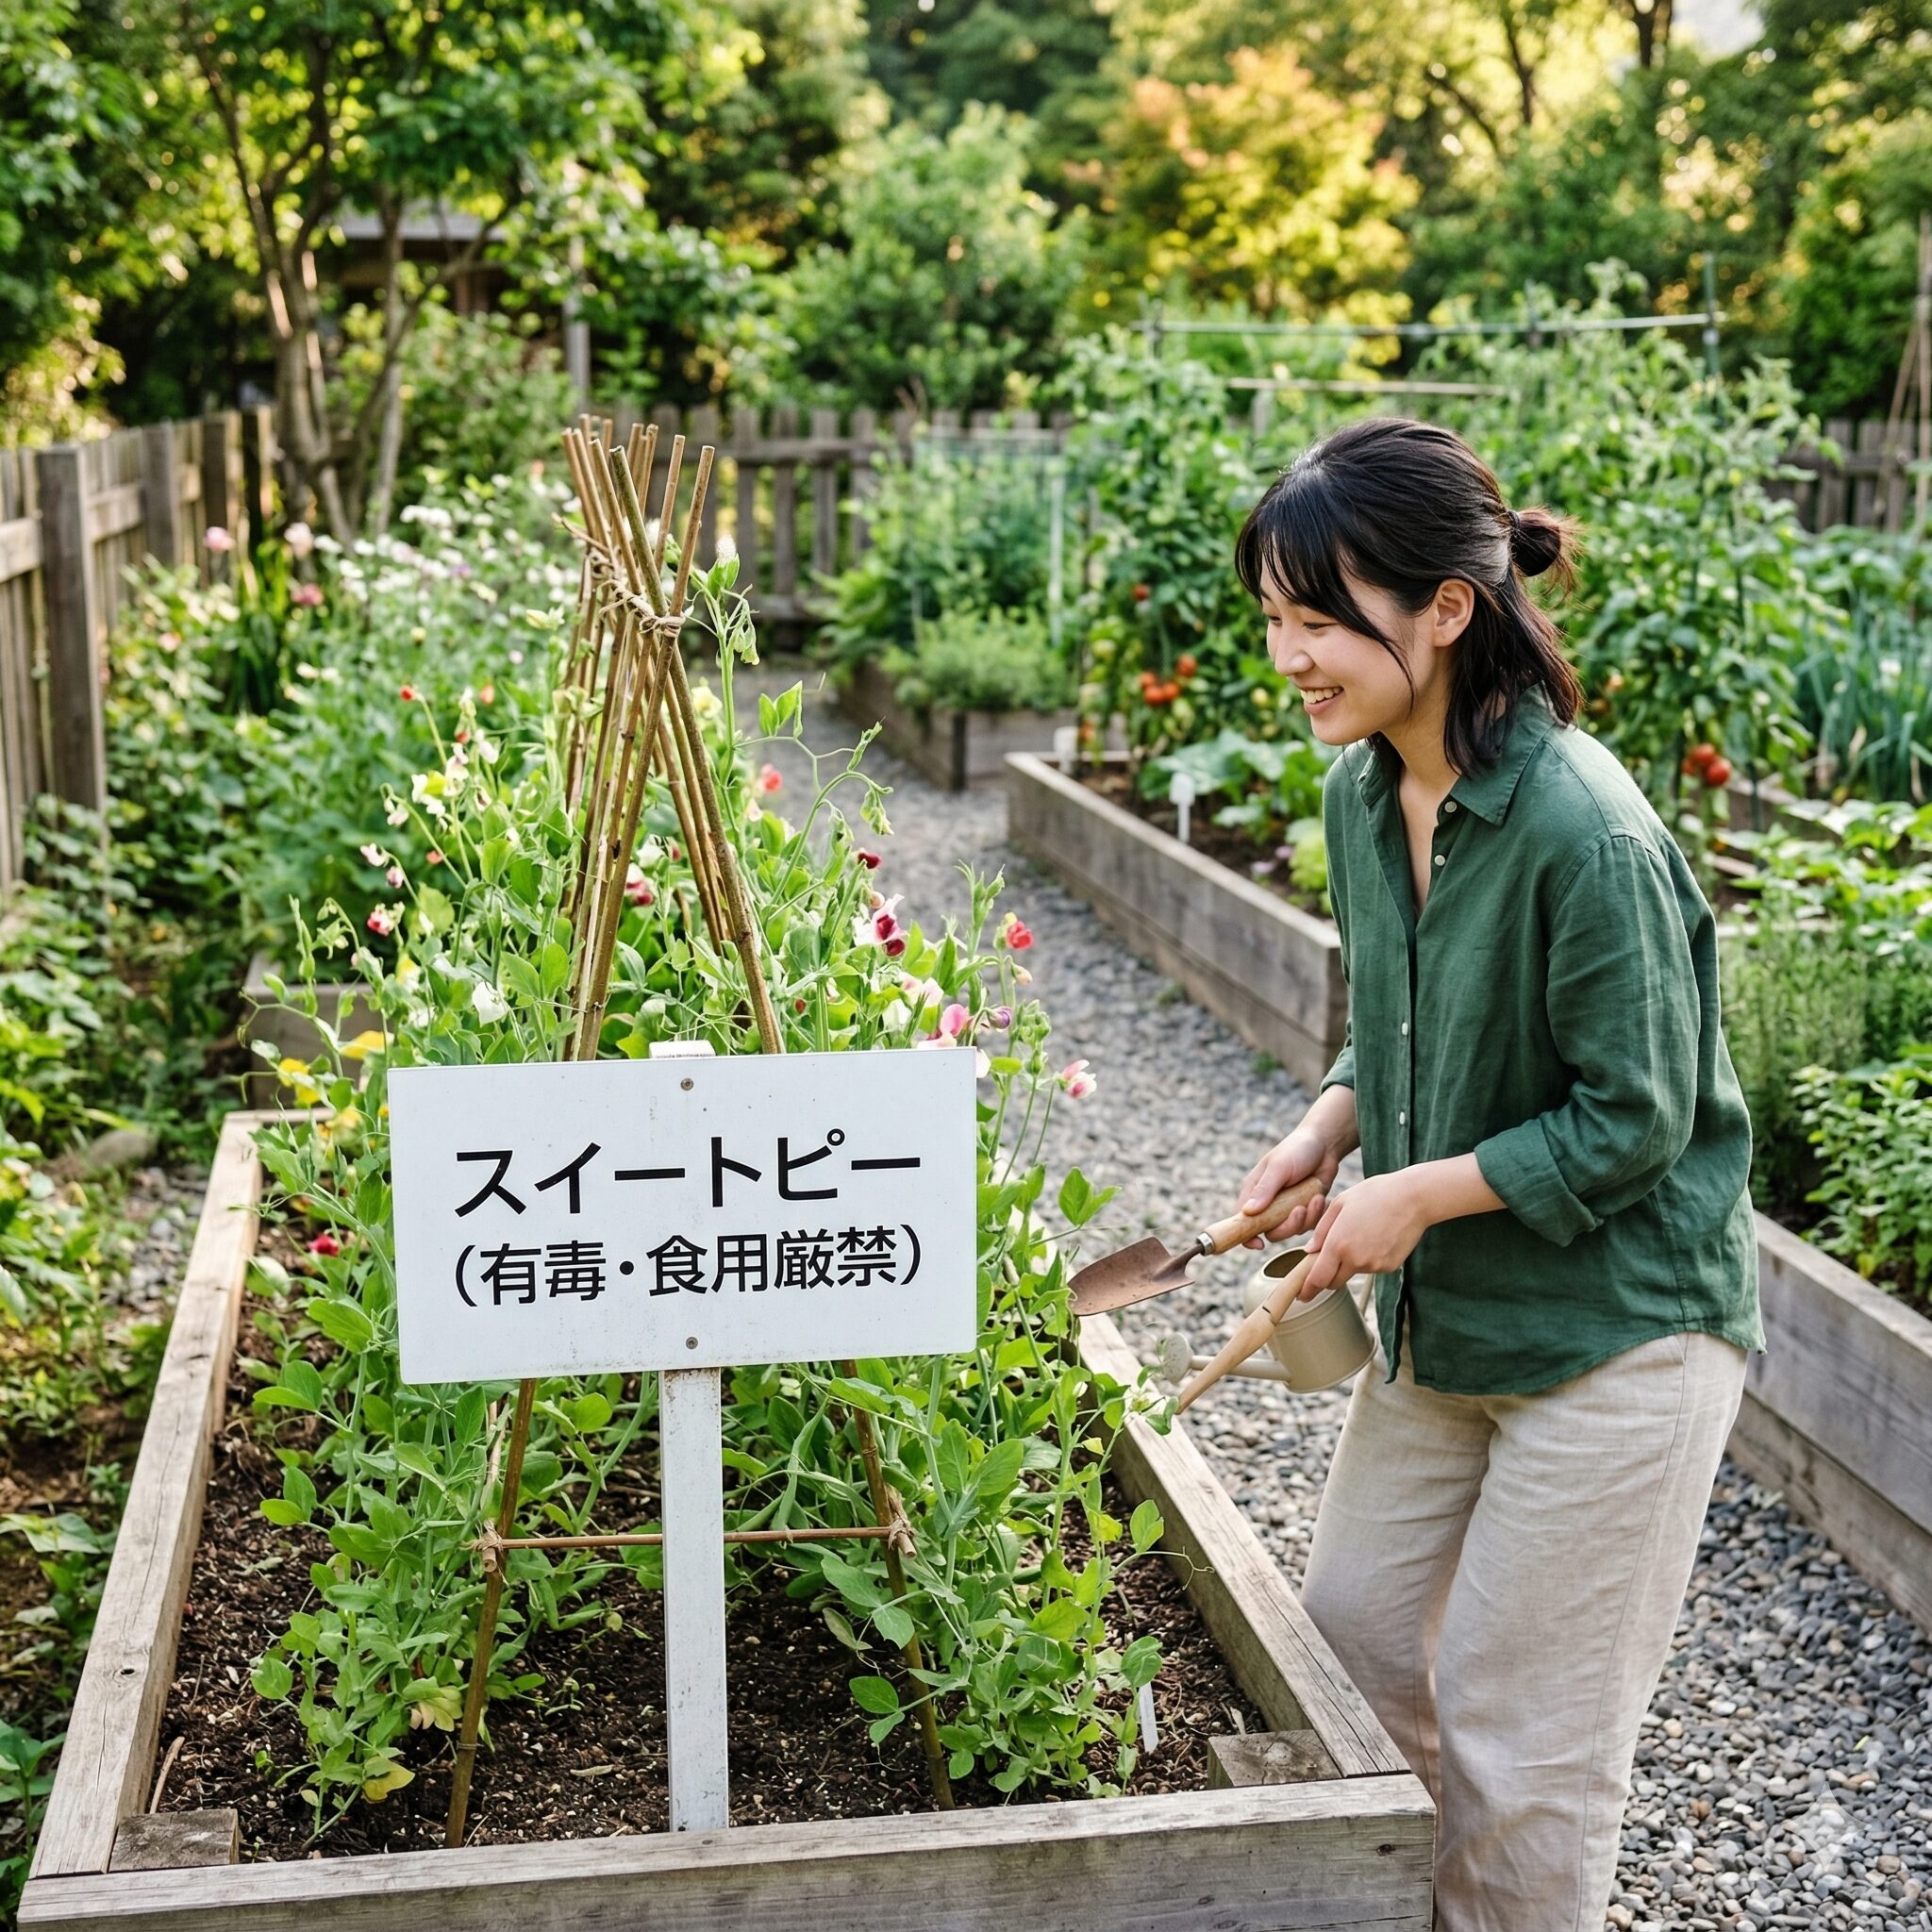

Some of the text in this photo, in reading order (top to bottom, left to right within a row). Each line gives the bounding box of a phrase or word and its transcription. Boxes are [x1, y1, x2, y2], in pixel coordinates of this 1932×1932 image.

[454, 1128, 921, 1218] スイートピー
[454, 1224, 922, 1307] (有毒・食用厳禁)
